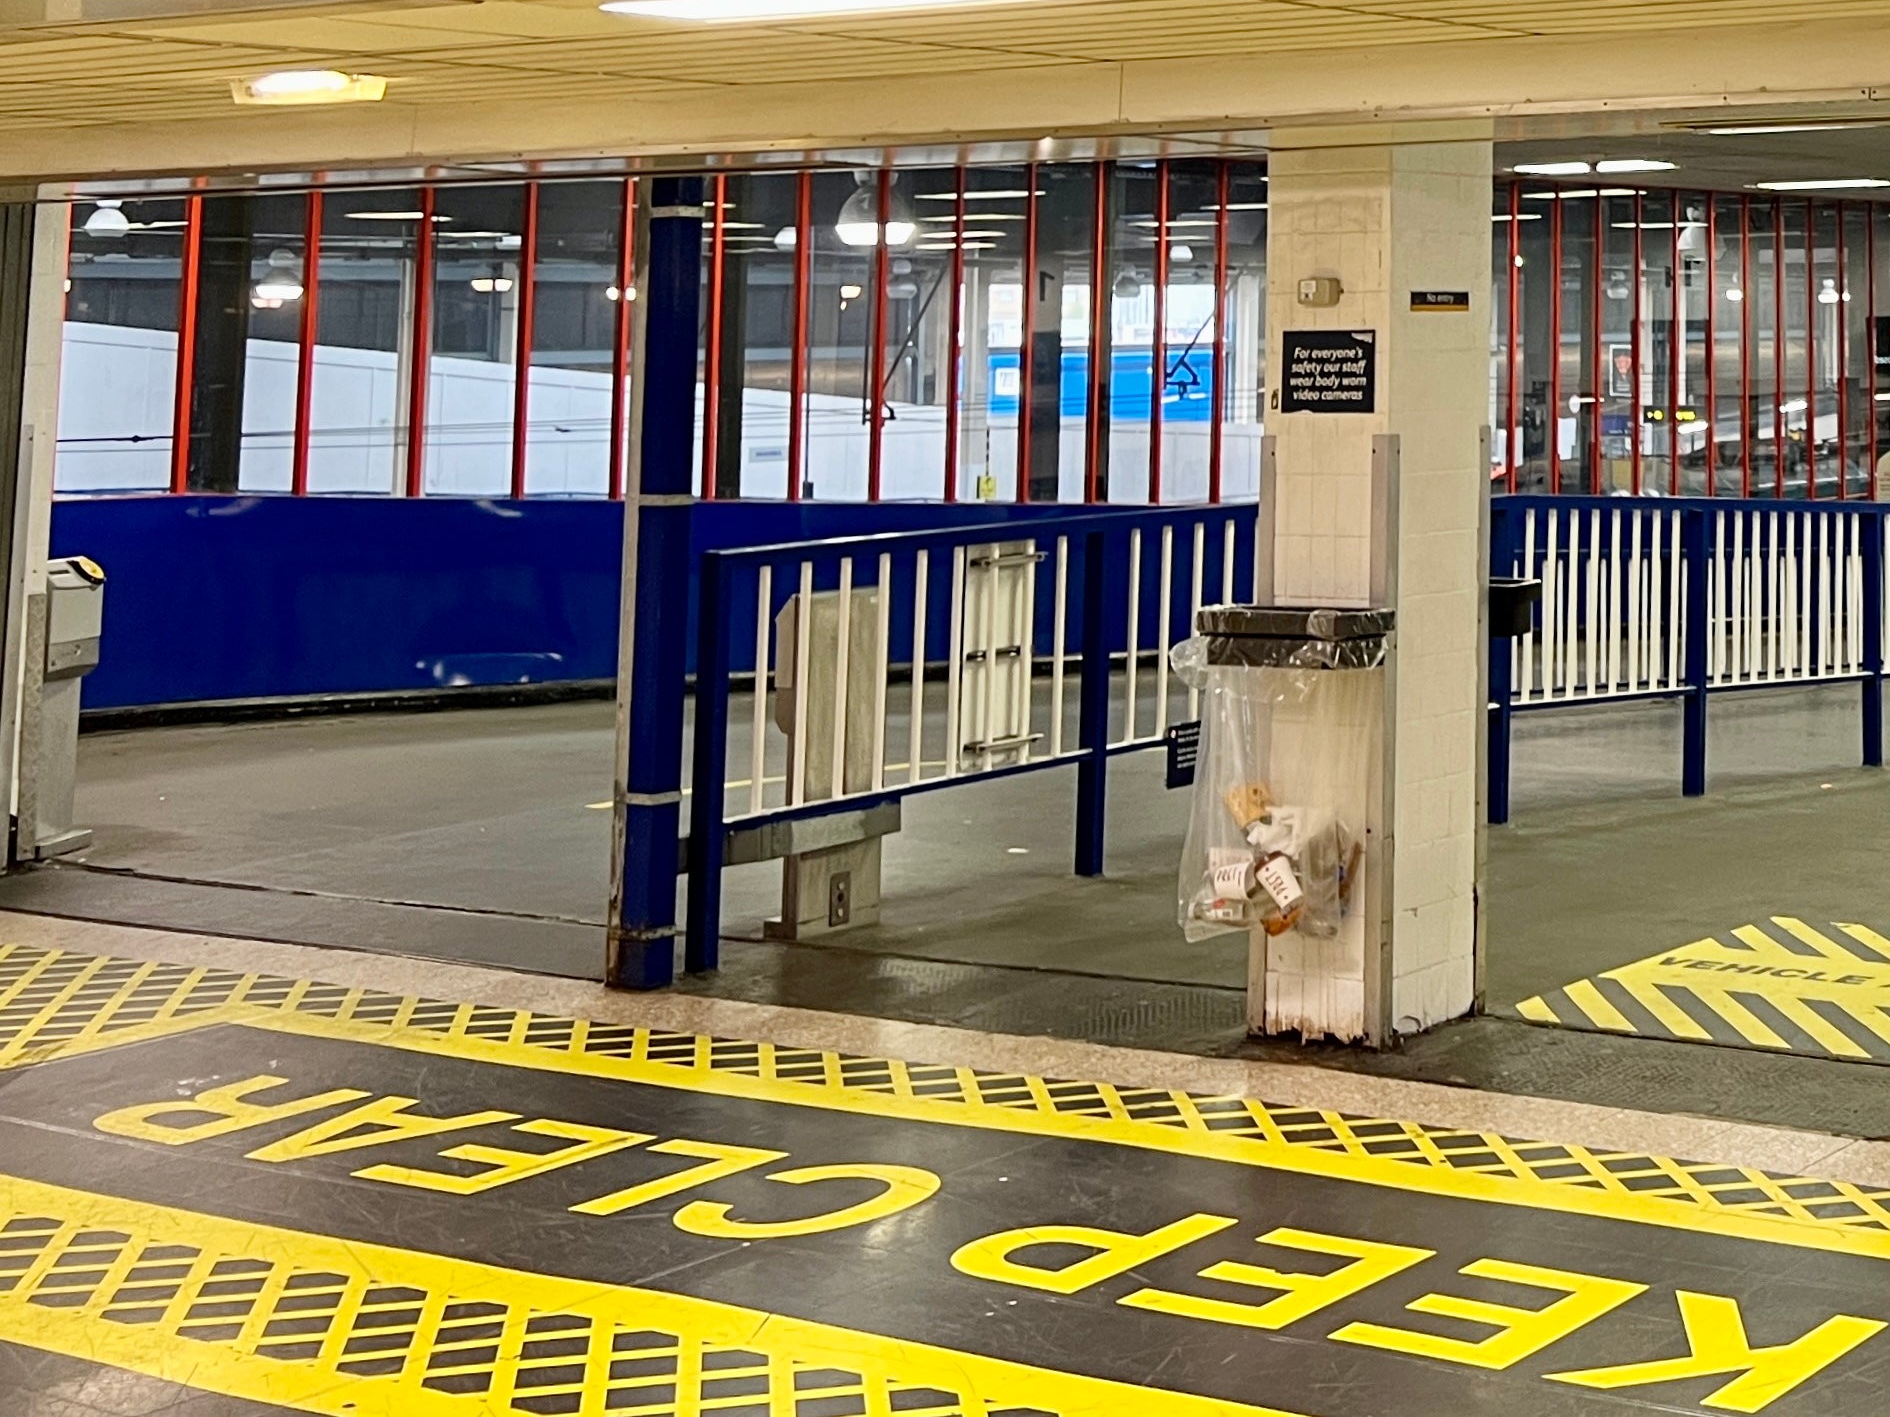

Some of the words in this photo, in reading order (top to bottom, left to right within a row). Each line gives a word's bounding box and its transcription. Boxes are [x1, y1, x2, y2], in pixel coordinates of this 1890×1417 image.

[1293, 347, 1310, 359] For
[1311, 346, 1363, 361] everyone's
[1291, 360, 1322, 375] safety
[1323, 363, 1341, 373] our
[1342, 360, 1367, 374] staff
[1290, 377, 1314, 386] wear
[1314, 374, 1340, 389] body
[1342, 377, 1366, 386] worn
[1293, 389, 1320, 400] video
[1321, 391, 1363, 400] cameras
[1657, 956, 1875, 986] VEHICLE
[92, 1074, 942, 1239] CLEAR
[950, 1213, 1889, 1413] KEEP
